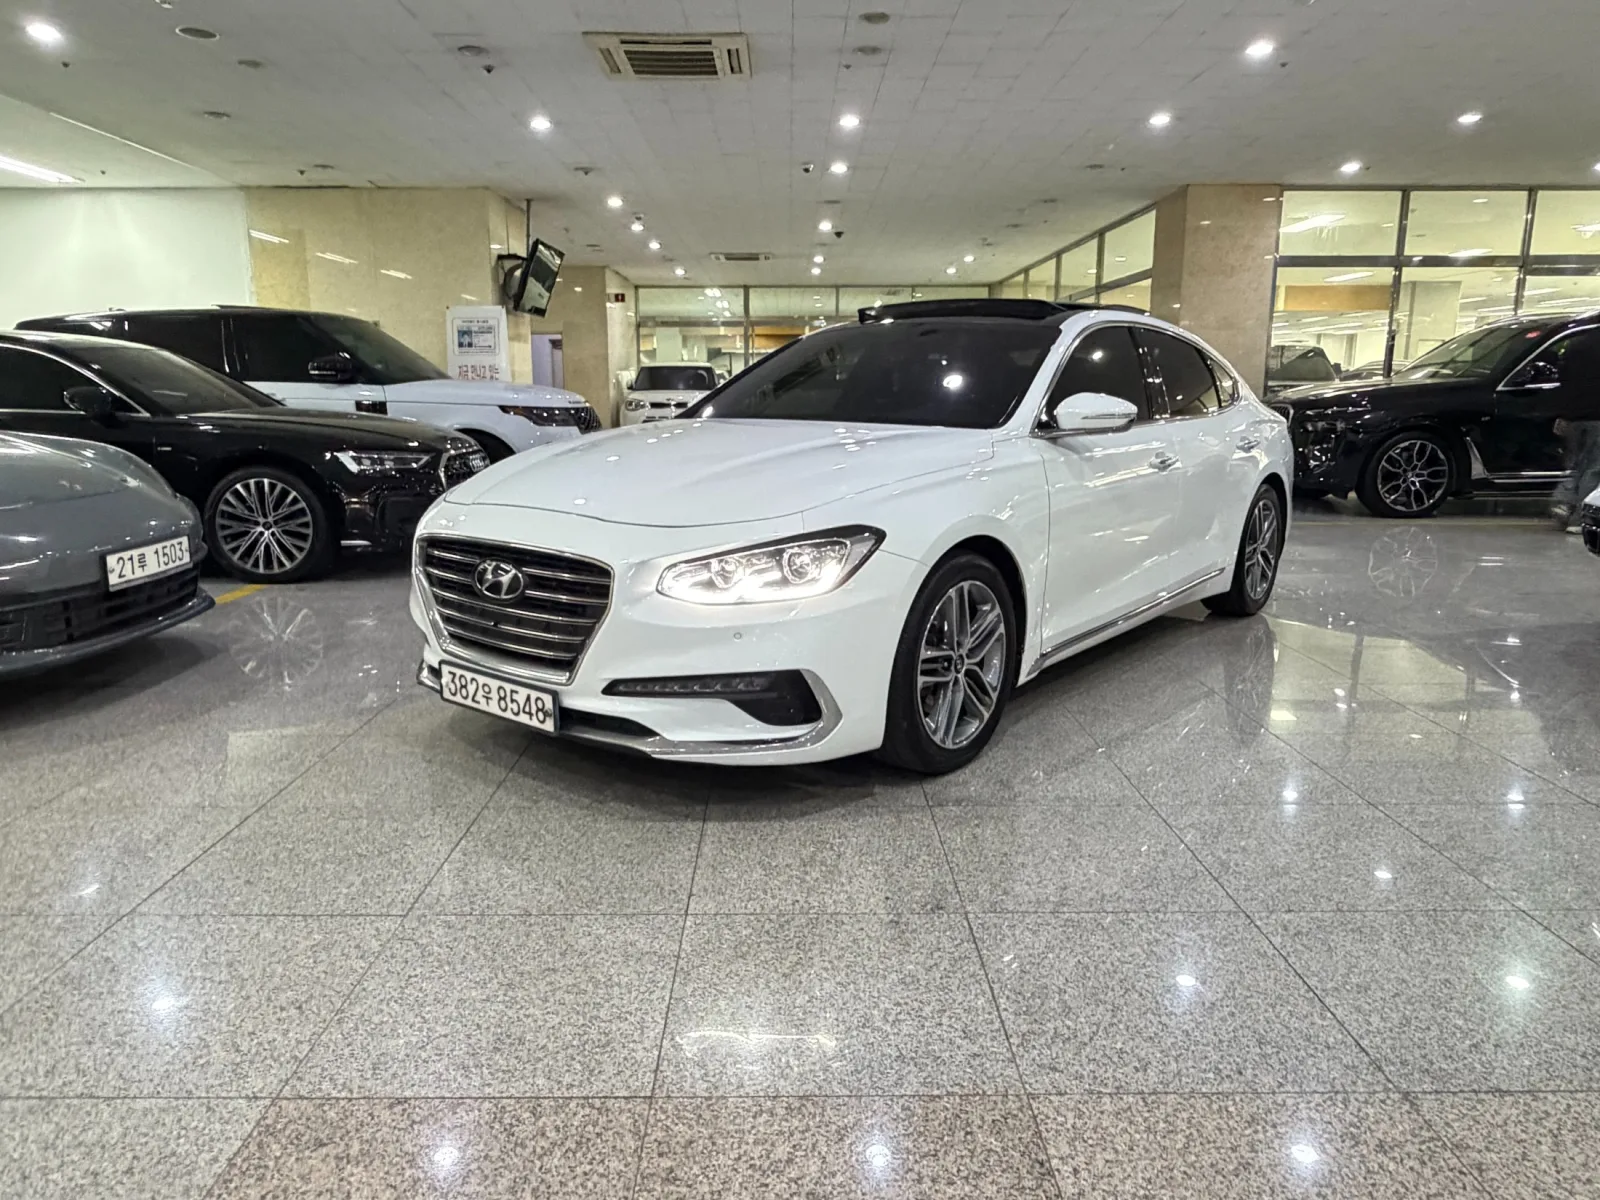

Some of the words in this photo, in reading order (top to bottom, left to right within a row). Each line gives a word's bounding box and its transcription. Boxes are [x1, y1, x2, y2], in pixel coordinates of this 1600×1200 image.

[116, 553, 147, 579] 21루
[154, 541, 184, 568] 1503
[497, 686, 547, 724] 8548
